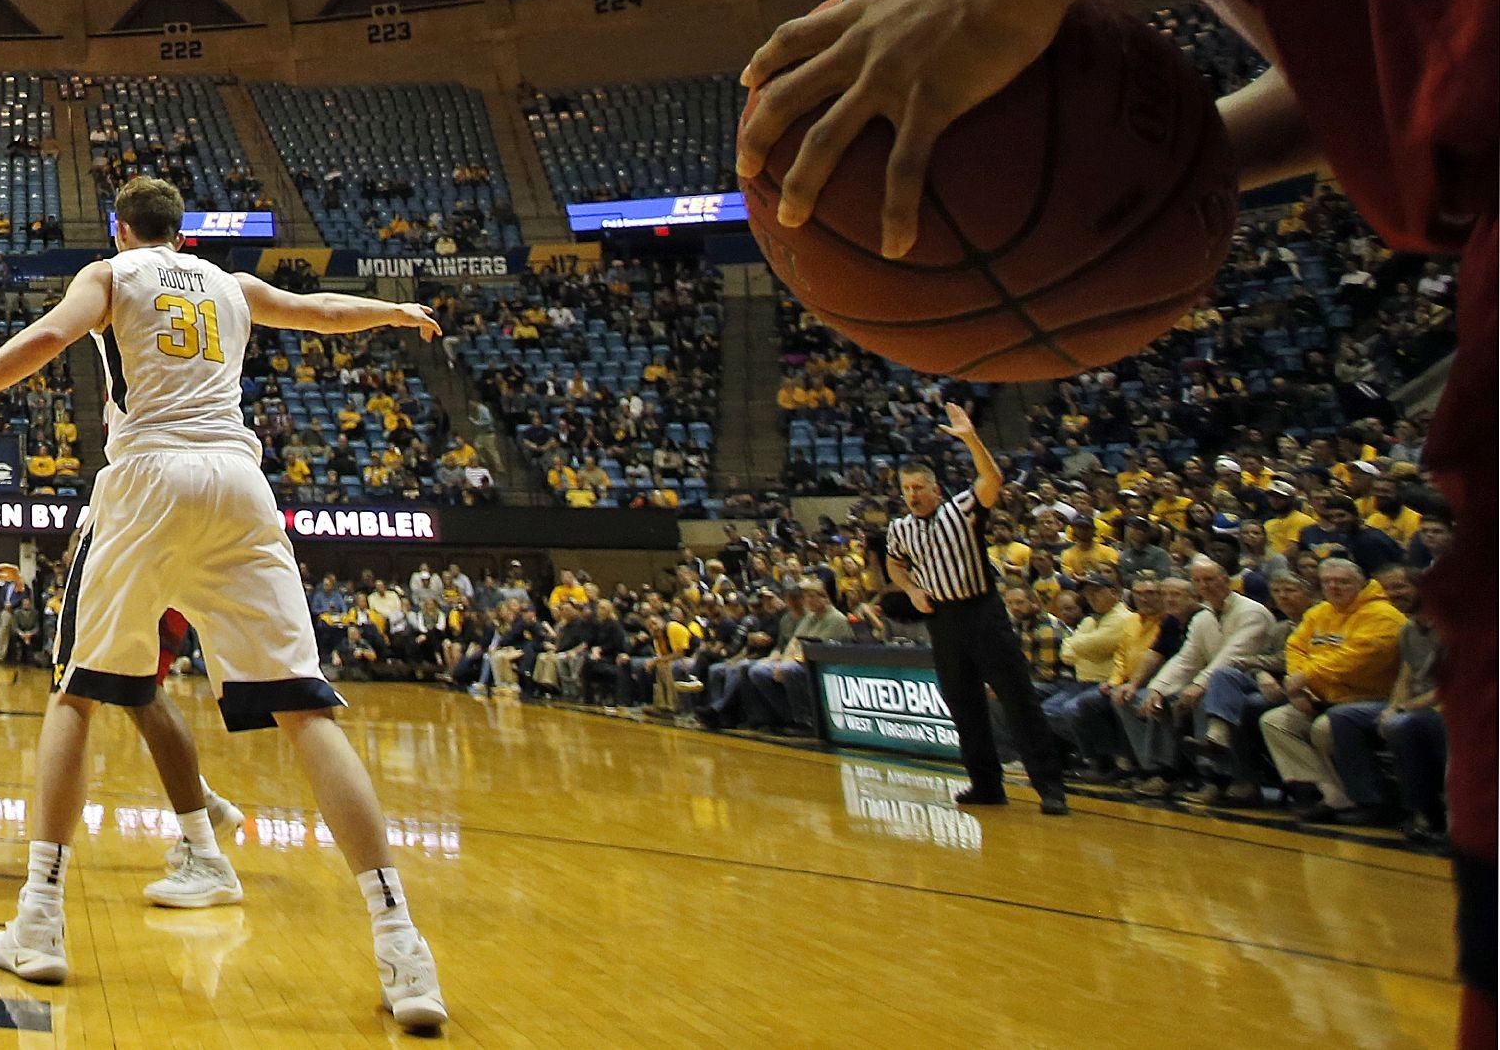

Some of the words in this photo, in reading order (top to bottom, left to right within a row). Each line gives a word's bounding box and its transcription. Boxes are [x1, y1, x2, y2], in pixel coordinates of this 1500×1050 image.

[367, 21, 412, 44] 223
[159, 40, 203, 60] 222
[157, 267, 206, 293] ROUTT
[154, 293, 225, 364] 31
[31, 504, 69, 530] BY
[294, 509, 434, 538] GAMBLER
[838, 675, 906, 711] UNITED
[902, 680, 952, 717] BAN
[875, 718, 937, 743] VIRGINIA'S
[936, 725, 961, 748] BAN
